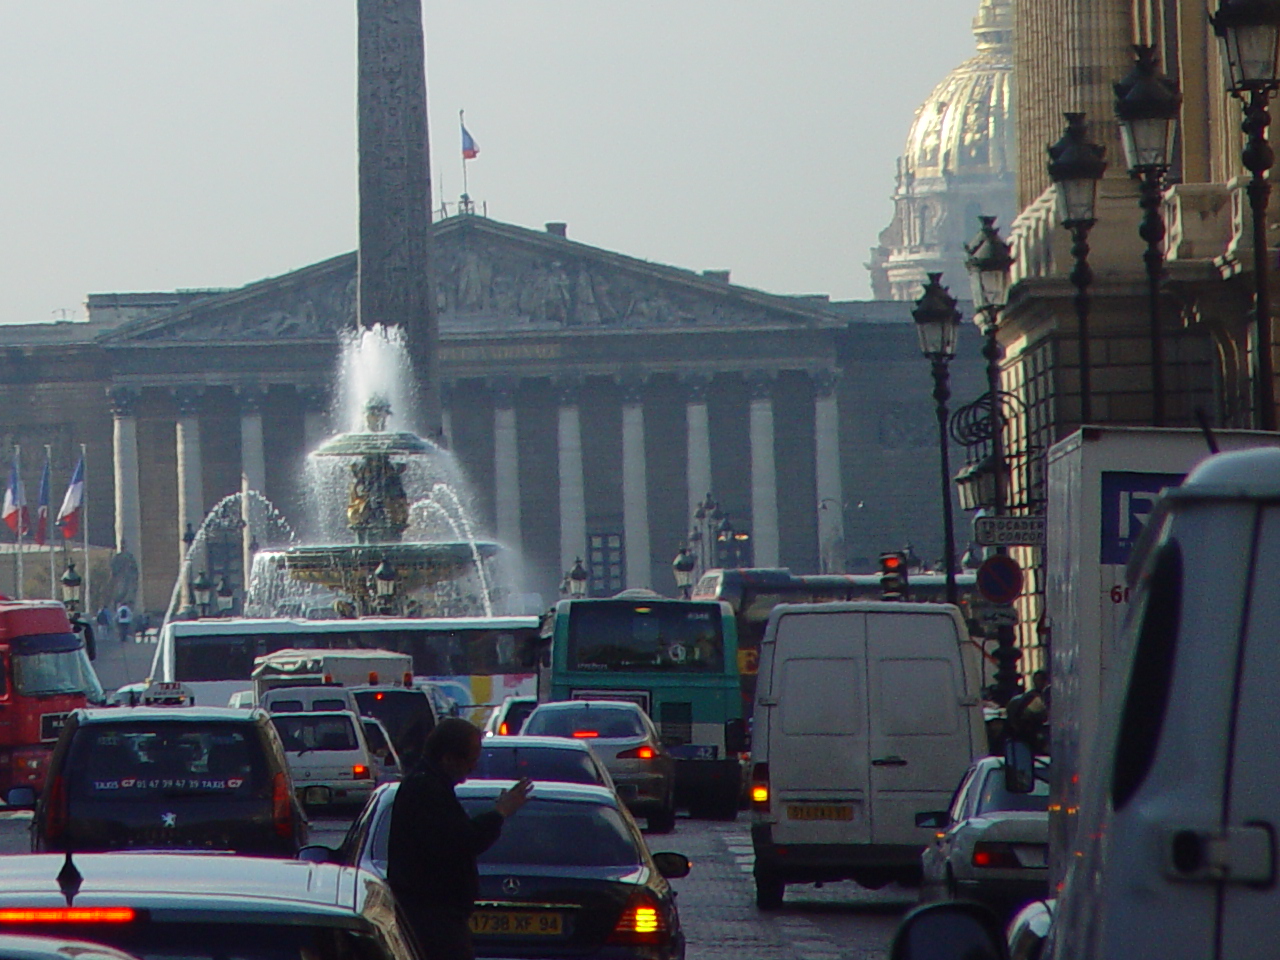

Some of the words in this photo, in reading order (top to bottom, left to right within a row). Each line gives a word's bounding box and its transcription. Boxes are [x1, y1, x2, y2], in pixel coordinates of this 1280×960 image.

[982, 520, 1044, 530] TROCADER
[998, 532, 1044, 541] CONCOR
[696, 747, 713, 759] 42
[121, 779, 135, 787] G7
[149, 780, 159, 788] 47
[175, 780, 186, 788] 47
[227, 779, 243, 788] G7
[473, 914, 510, 930] 1738
[515, 915, 533, 929] XF
[539, 916, 558, 930] 94
